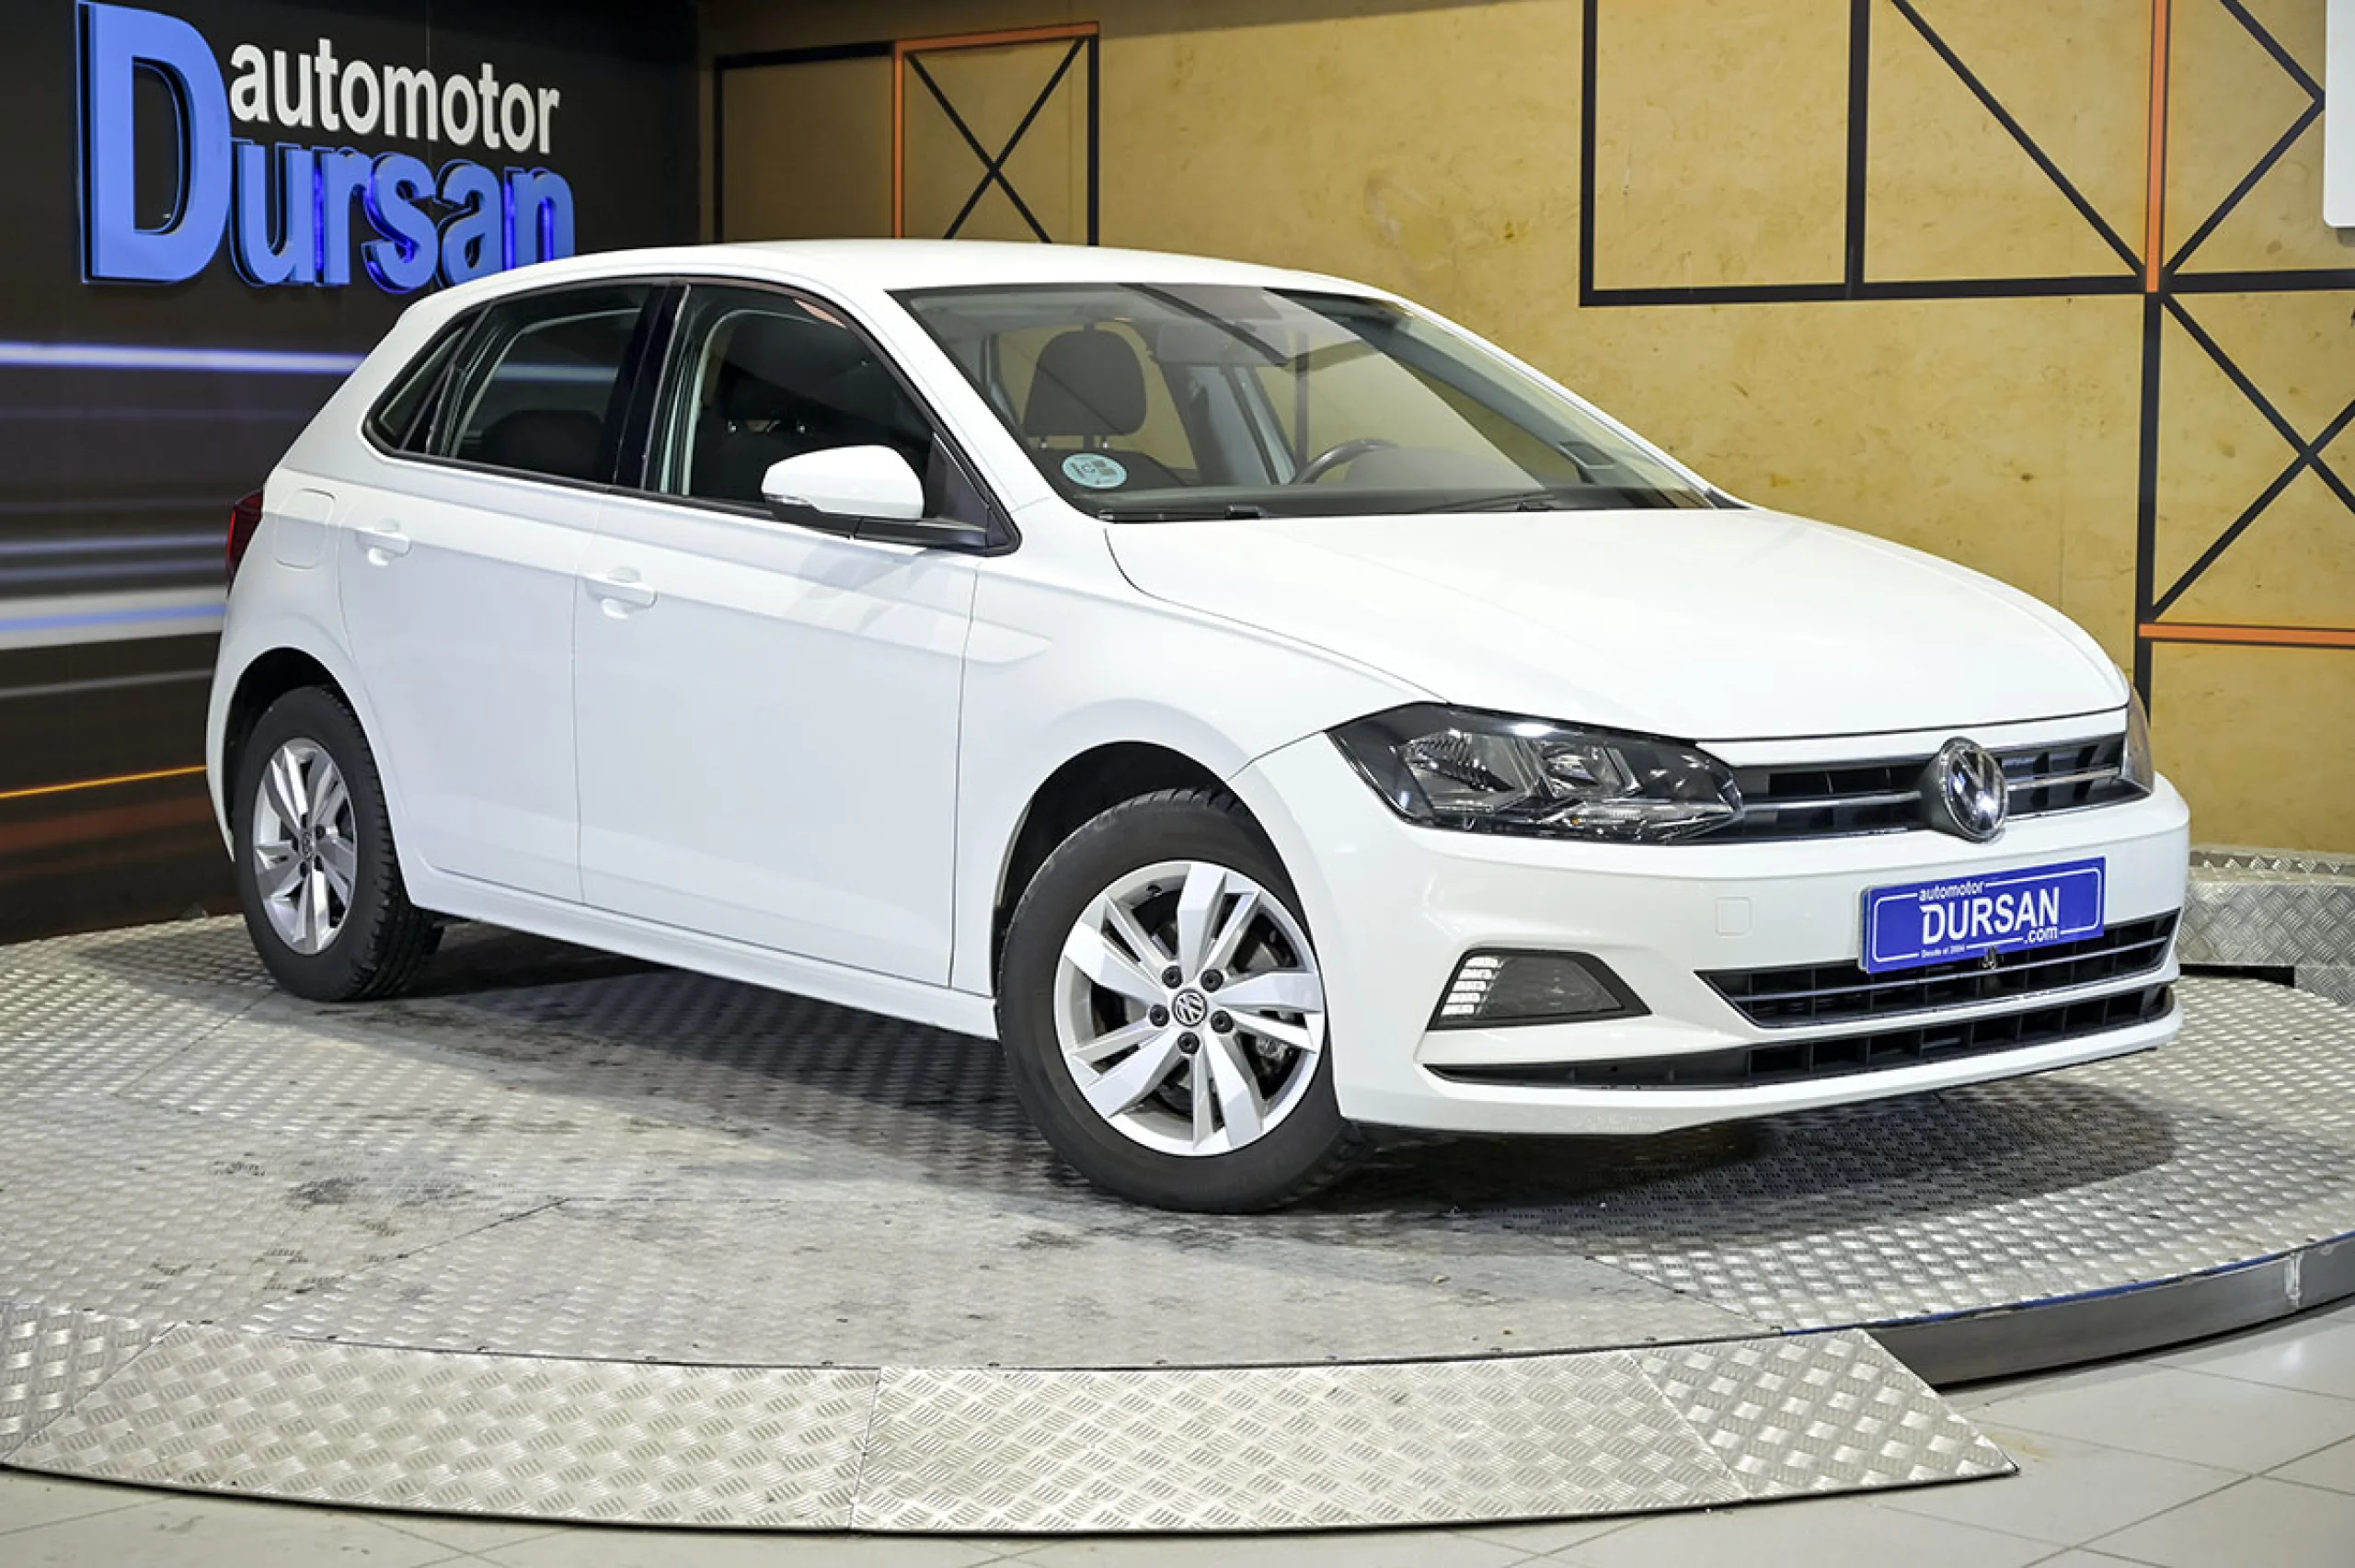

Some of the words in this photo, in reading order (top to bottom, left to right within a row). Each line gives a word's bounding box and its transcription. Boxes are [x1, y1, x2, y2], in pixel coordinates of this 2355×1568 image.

[230, 38, 559, 154] automotor
[77, 1, 574, 292] Dursan
[1919, 881, 1984, 901] automotor
[1920, 887, 2060, 944] DURSAN
[2024, 925, 2059, 944] .com
